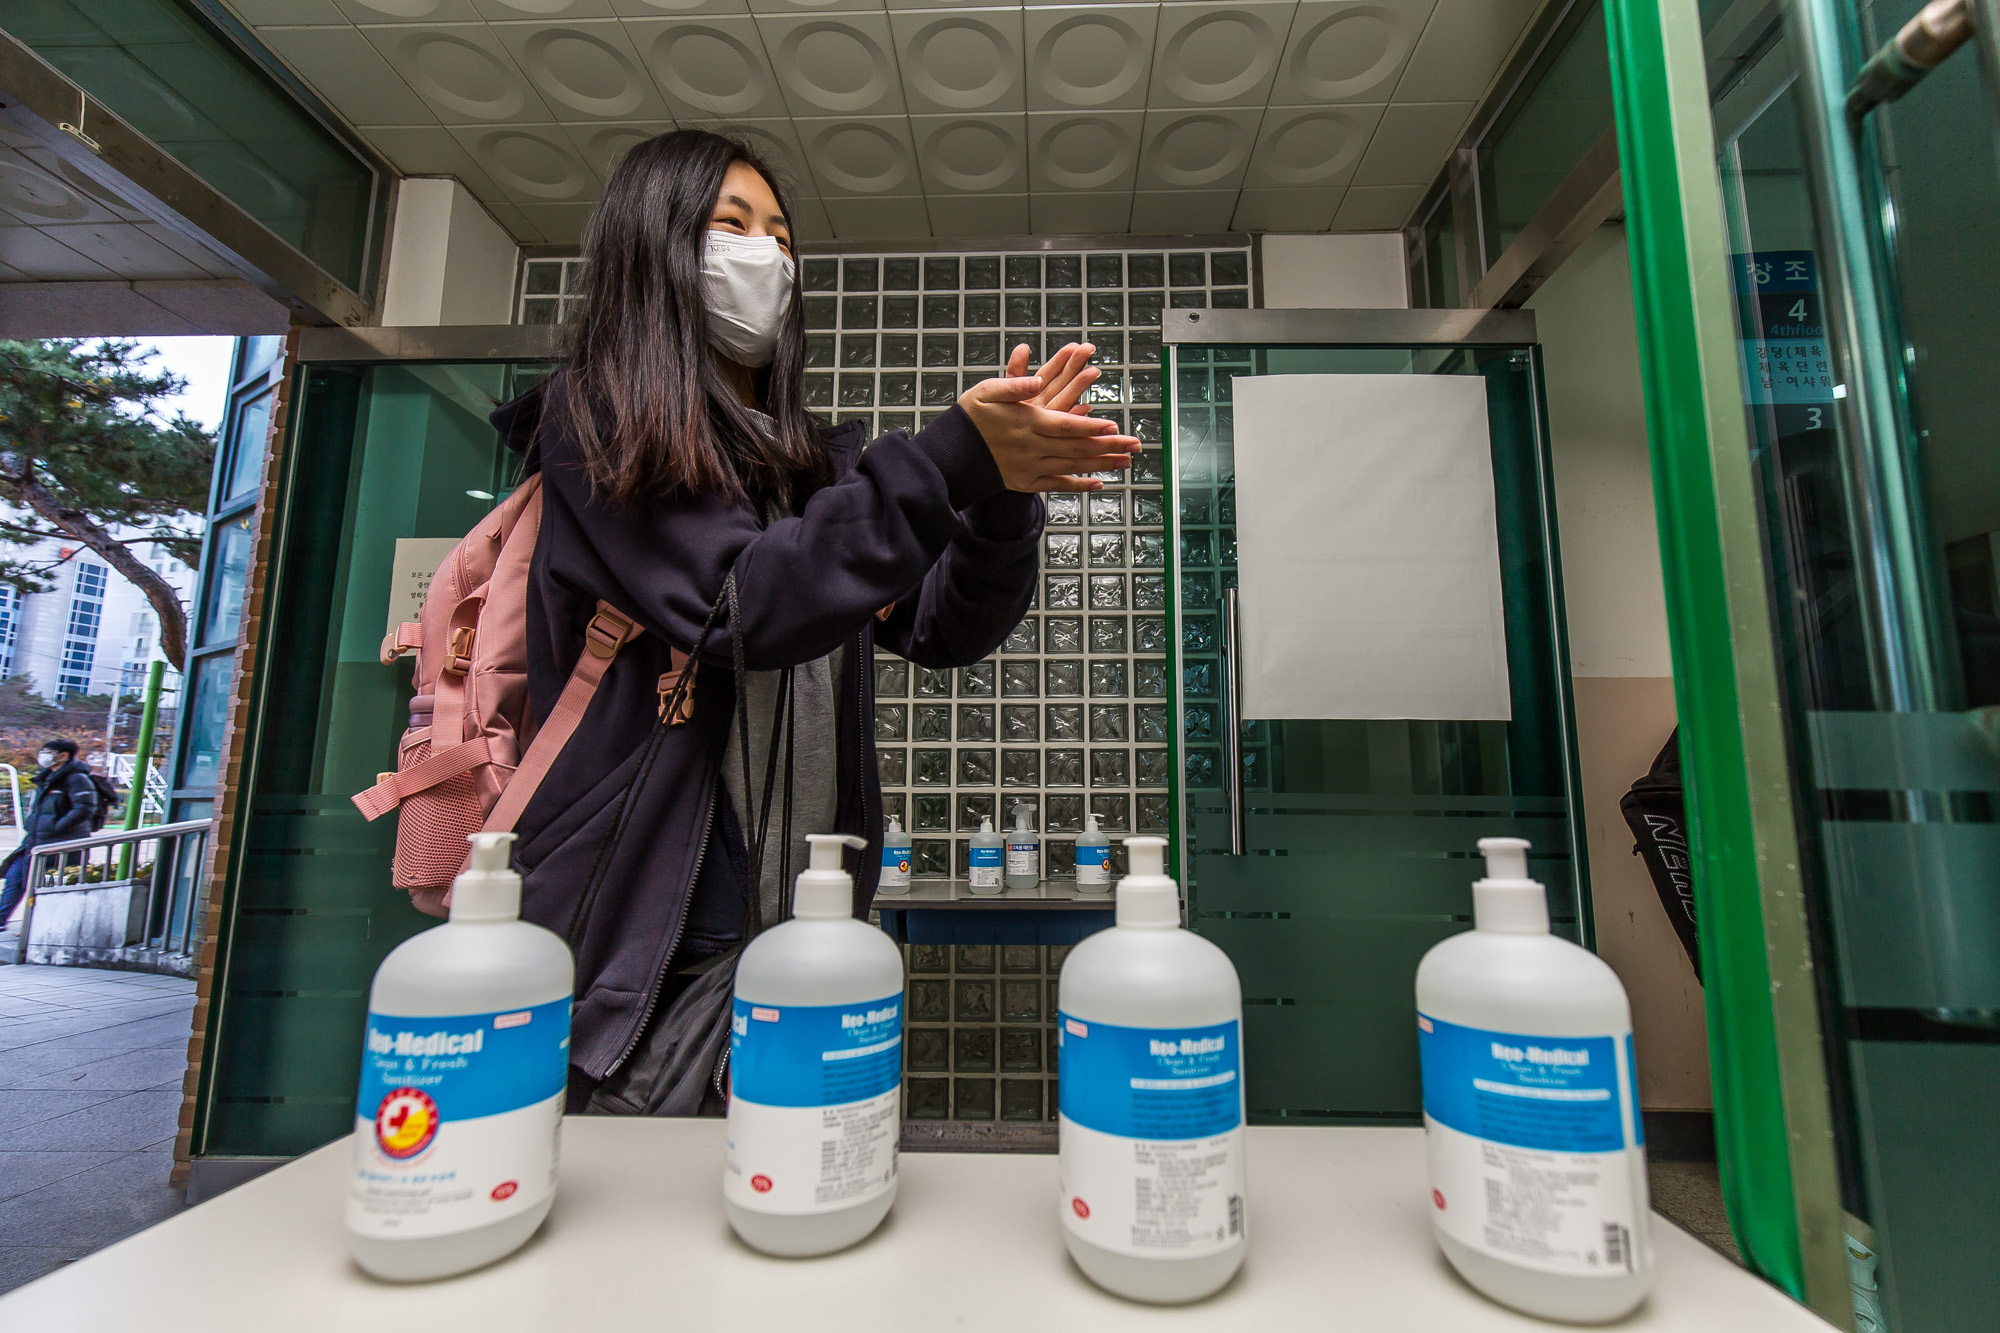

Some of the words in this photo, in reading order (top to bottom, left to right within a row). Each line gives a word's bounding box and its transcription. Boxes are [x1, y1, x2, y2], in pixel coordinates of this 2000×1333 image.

[1788, 298, 1808, 322] 4
[1769, 323, 1823, 337] 4thfloo
[1756, 345, 1824, 360] 강당(체육
[1805, 407, 1822, 431] 3
